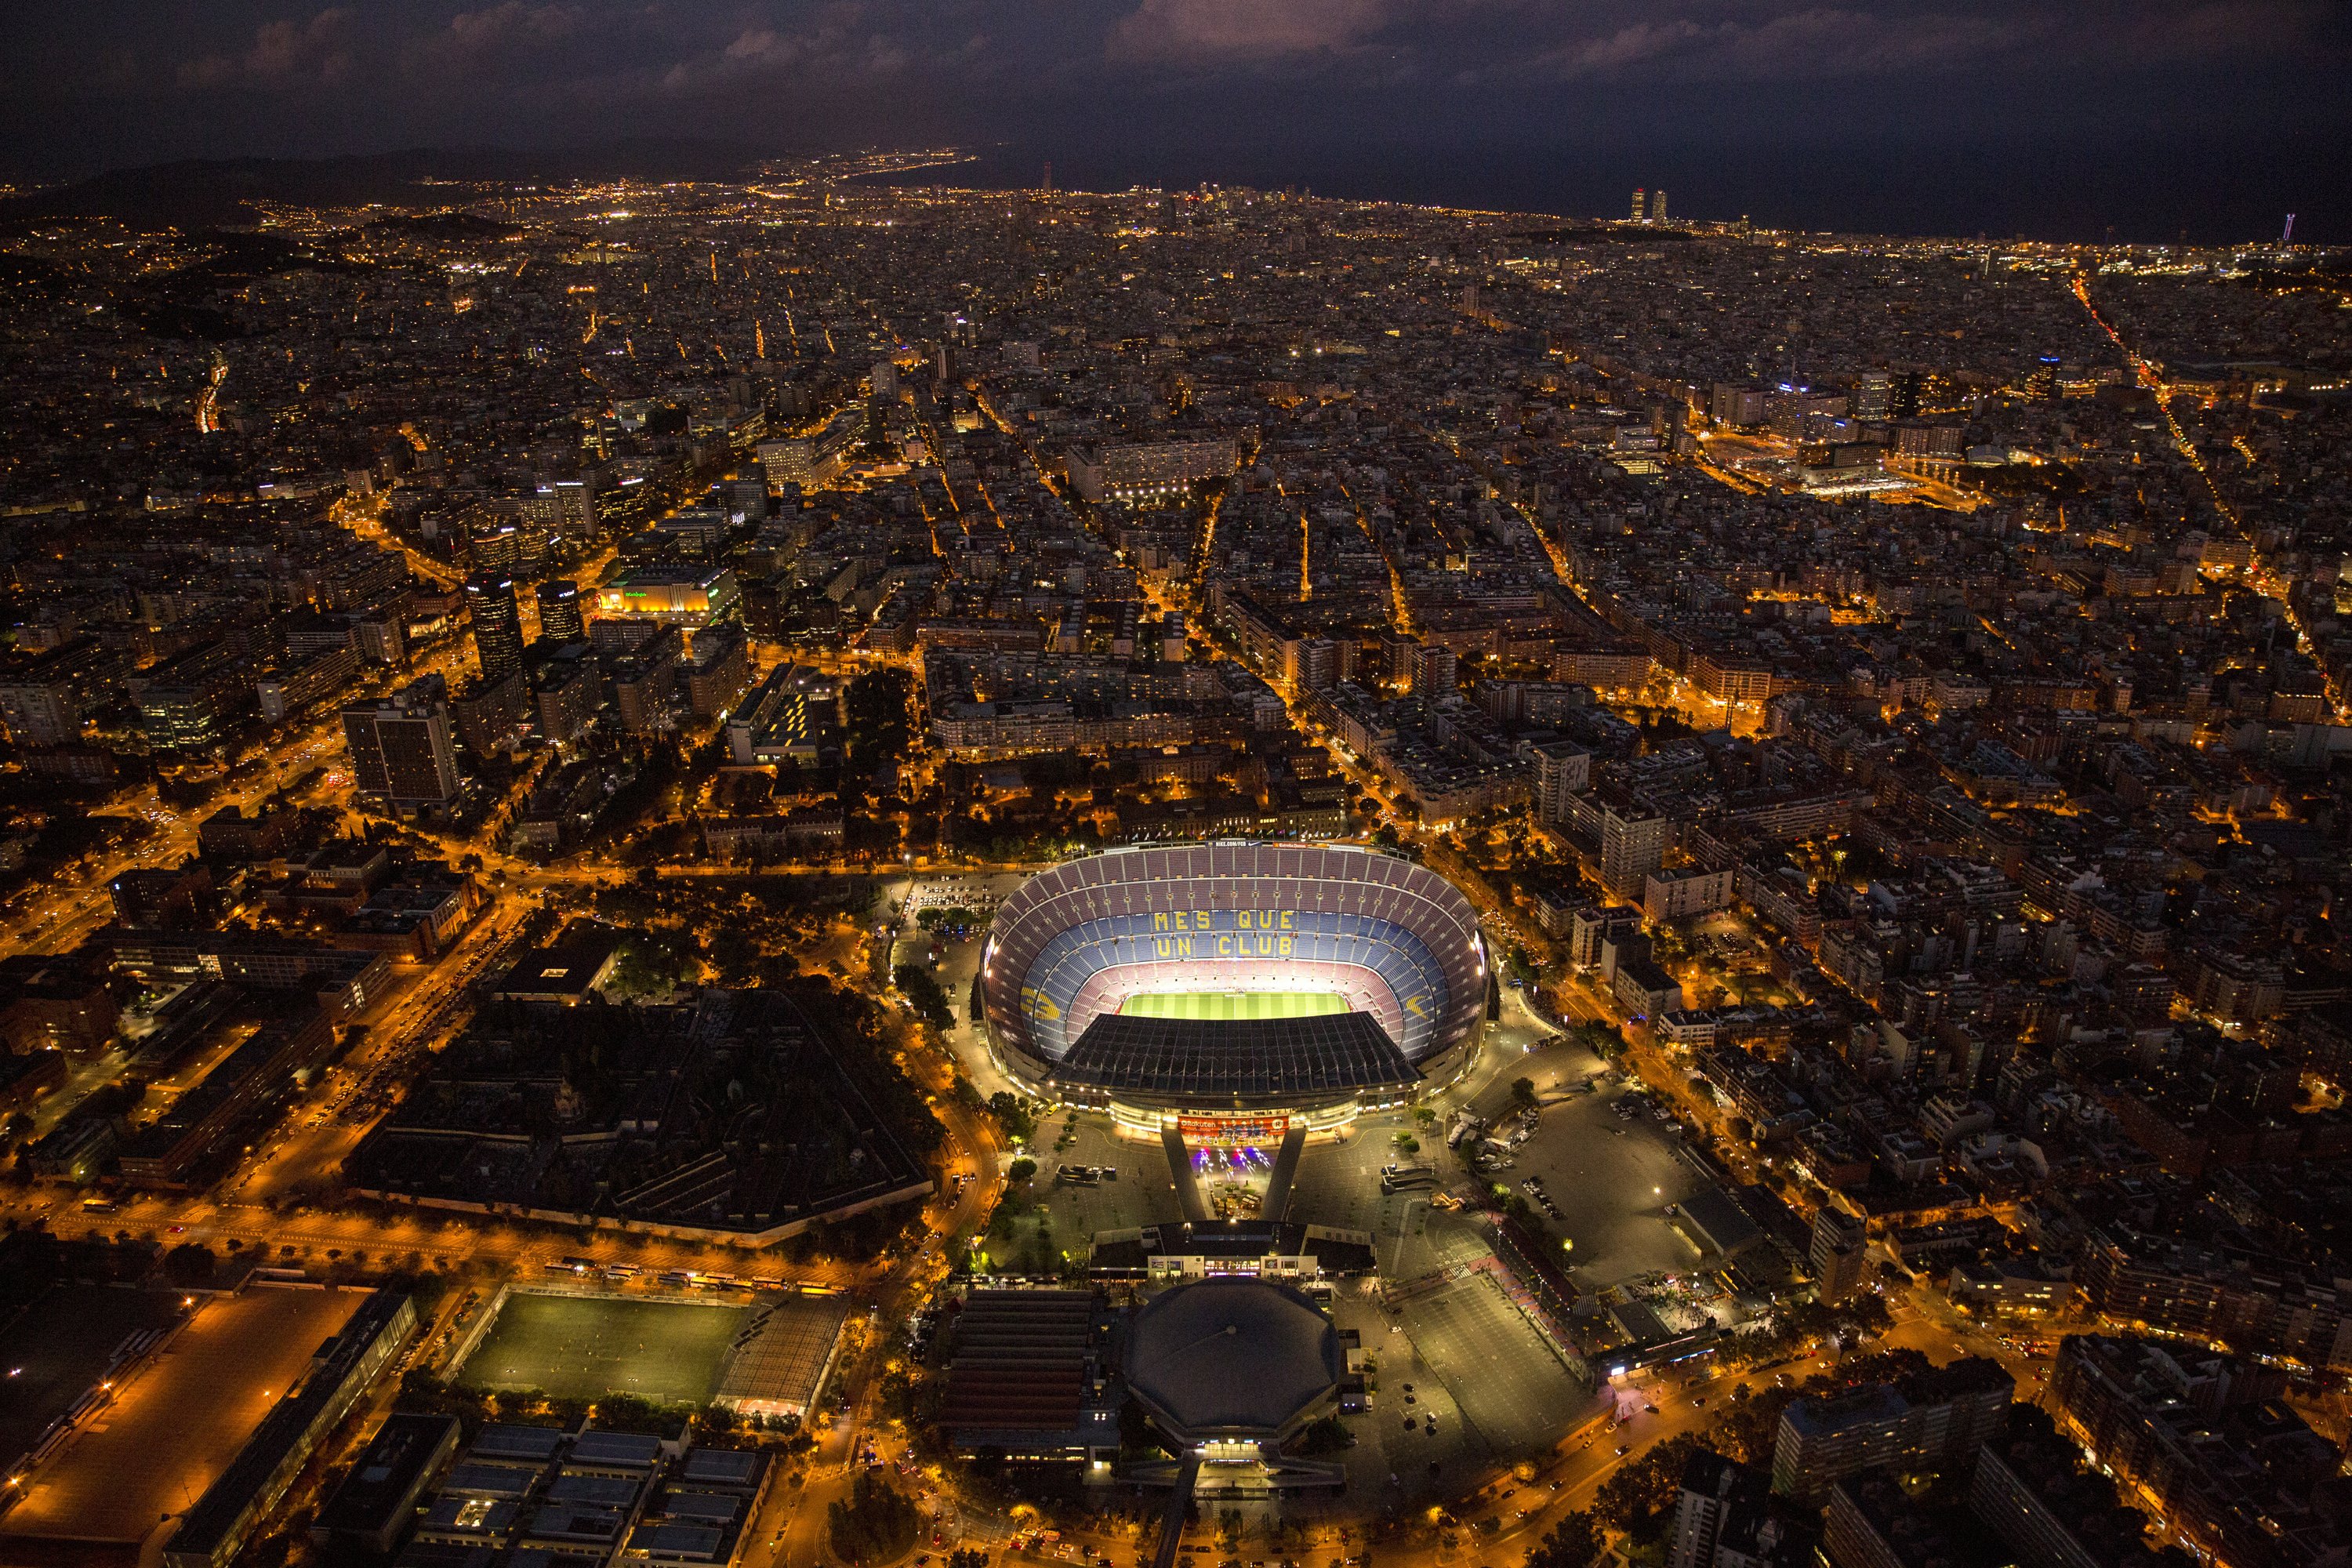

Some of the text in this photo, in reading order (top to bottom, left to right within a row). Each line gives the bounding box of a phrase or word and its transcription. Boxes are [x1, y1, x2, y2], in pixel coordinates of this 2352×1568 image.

[1154, 910, 1293, 931] MES QUE
[1157, 936, 1292, 956] UN CLUB
